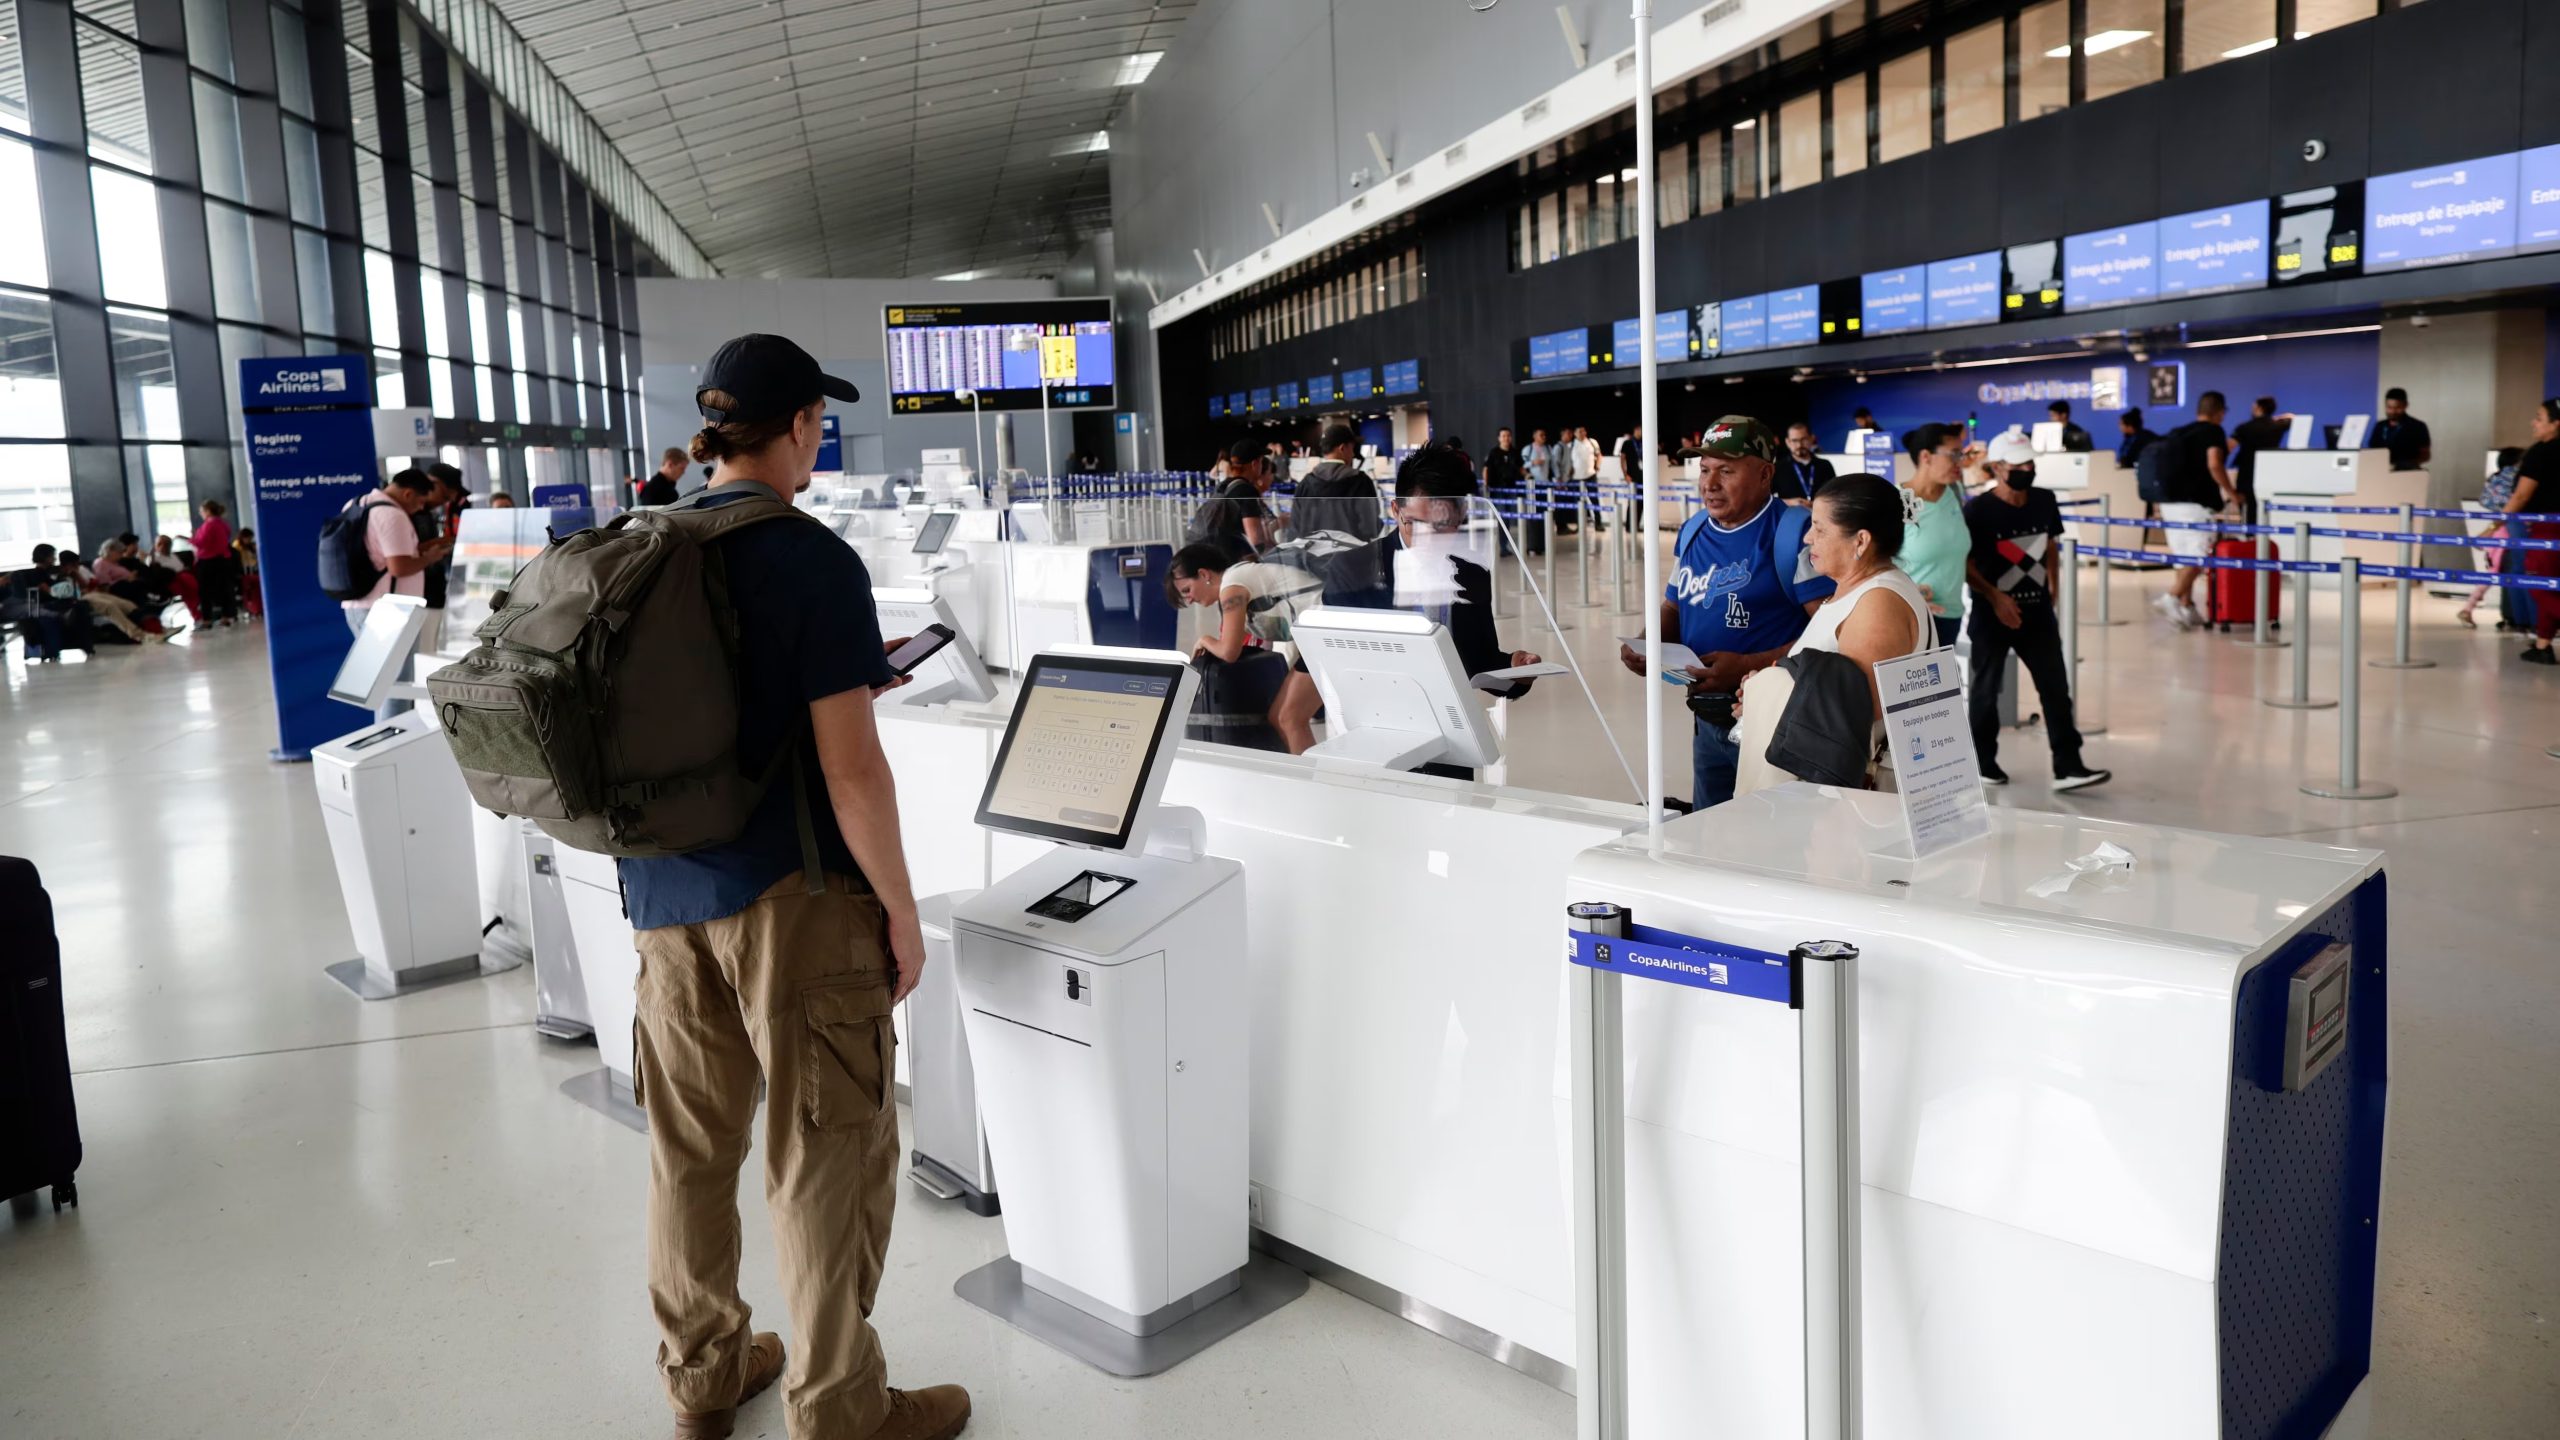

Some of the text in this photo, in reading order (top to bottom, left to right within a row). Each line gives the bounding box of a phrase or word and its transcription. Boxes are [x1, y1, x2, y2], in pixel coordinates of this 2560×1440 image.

[2376, 197, 2506, 229] Entrega de Equipaje
[2165, 236, 2260, 262] Entrega de Equipaje
[276, 370, 320, 383] Copa
[260, 381, 321, 394] Airlines
[254, 434, 302, 446] Registro
[259, 473, 363, 489] Entrega de Equipaje
[260, 490, 303, 501] Bag Drop
[1677, 558, 1752, 609] Dodgers
[1725, 592, 1749, 628] LA
[1905, 668, 1927, 680] Copa
[1899, 679, 1929, 694] Airlines
[1903, 715, 1925, 727] Equipaje
[1931, 709, 1950, 719] bodega
[1931, 739, 1937, 748] 23
[1937, 738, 1944, 747] kg
[1628, 952, 1708, 976] CopaAirlines
